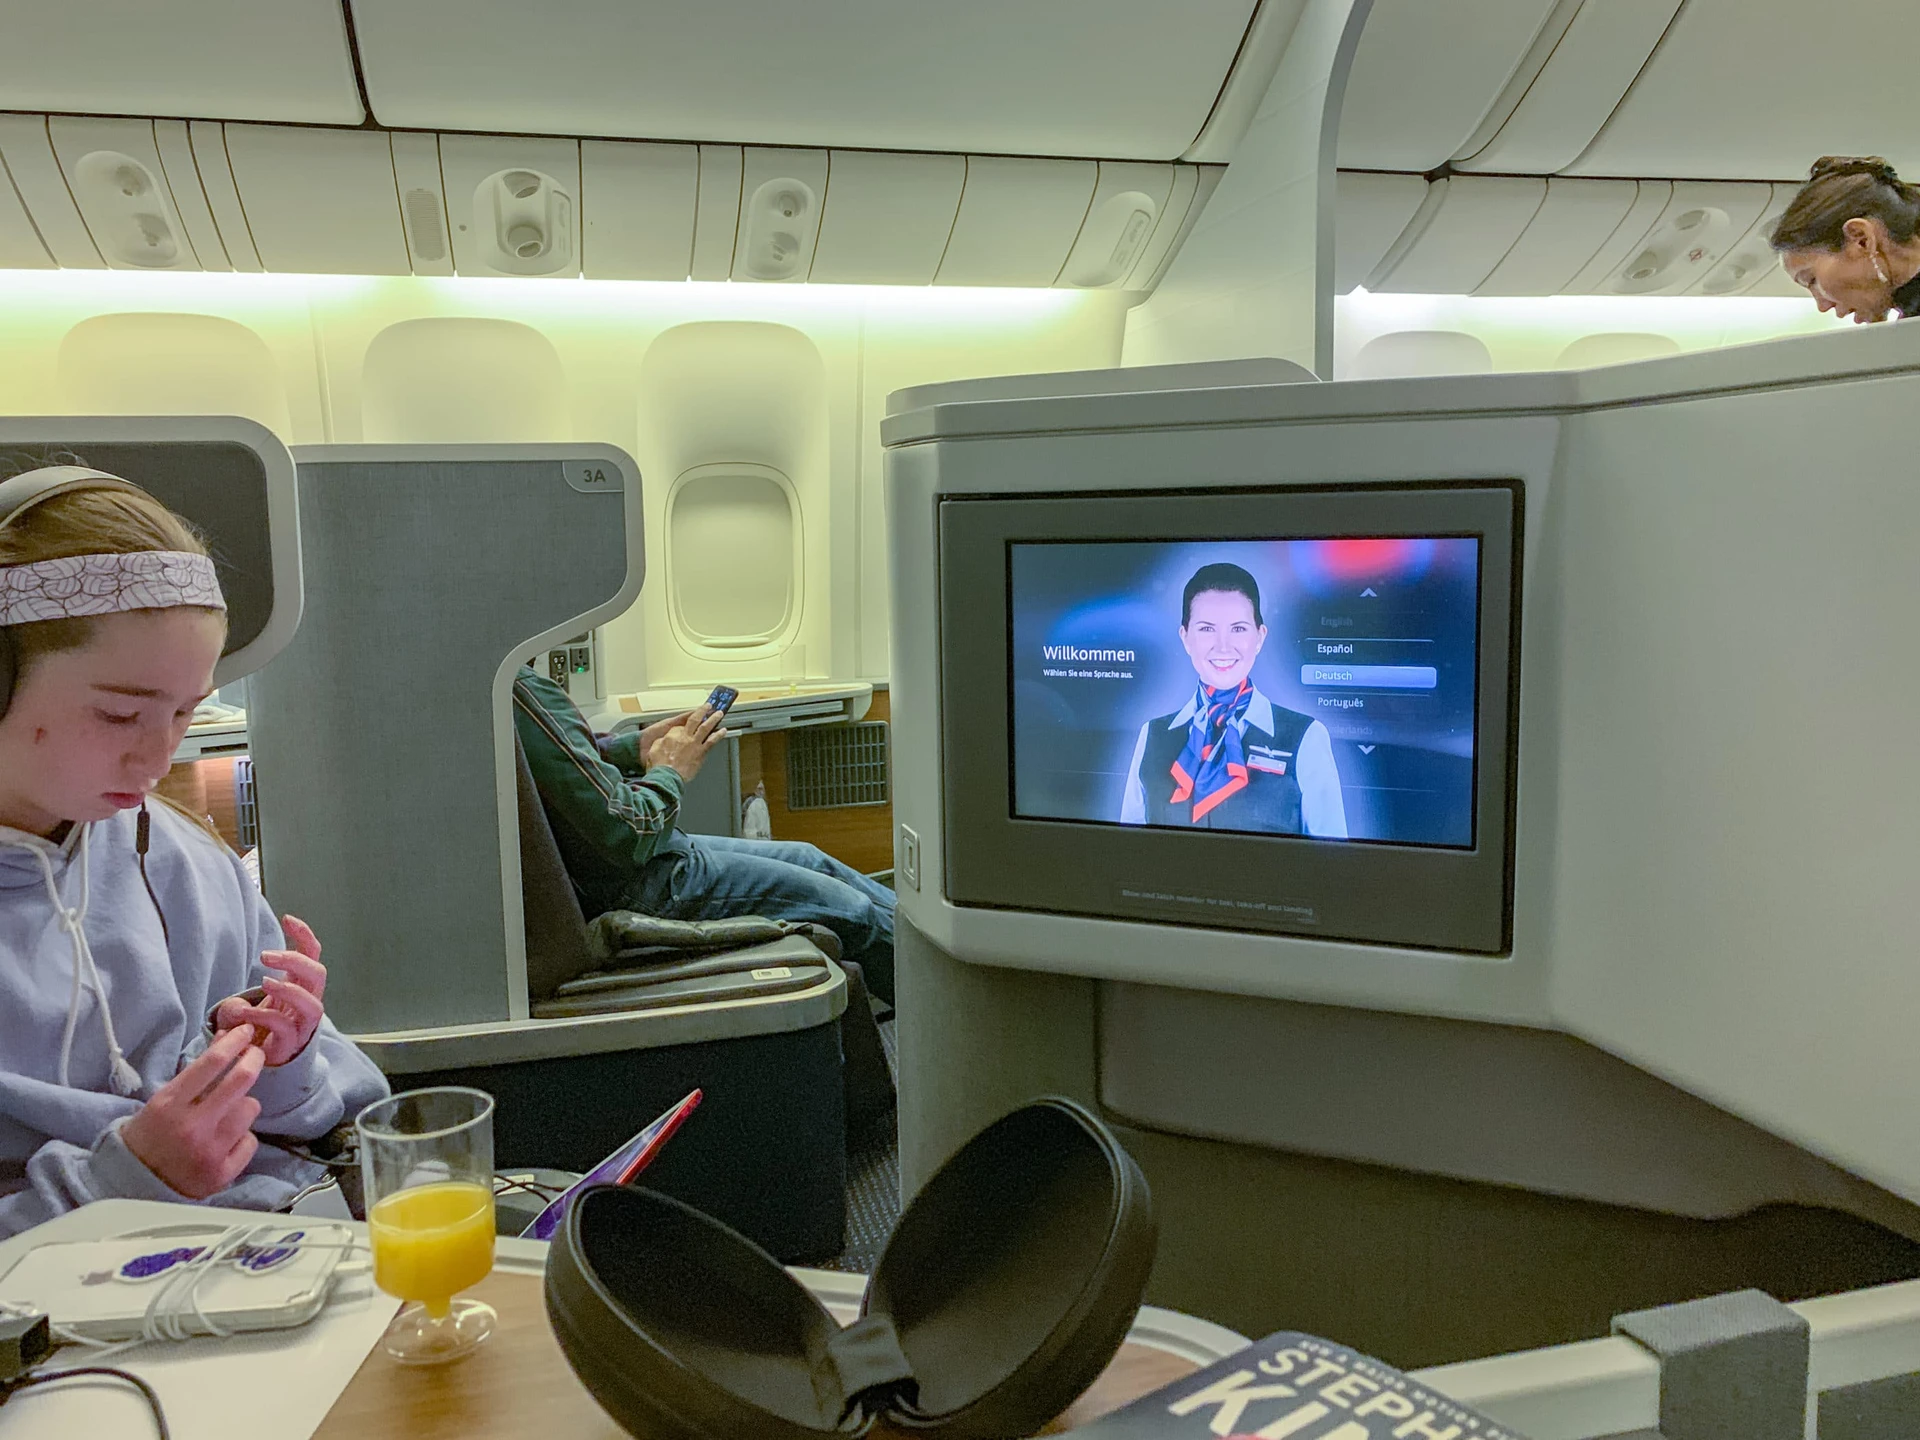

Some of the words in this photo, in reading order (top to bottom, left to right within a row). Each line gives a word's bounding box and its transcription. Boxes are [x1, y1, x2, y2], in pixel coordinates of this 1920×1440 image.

[583, 468, 606, 483] 3A
[1043, 645, 1135, 662] Willkommen
[1317, 643, 1353, 655] Español
[1043, 668, 1067, 677] Wählen
[1068, 669, 1078, 677] Sie
[1079, 669, 1093, 678] eine
[1094, 669, 1119, 679] Sprache
[1120, 671, 1134, 679] aus.
[1315, 670, 1353, 681] Deutsch
[1317, 697, 1364, 709] Português
[1258, 1347, 1487, 1440] STEPH
